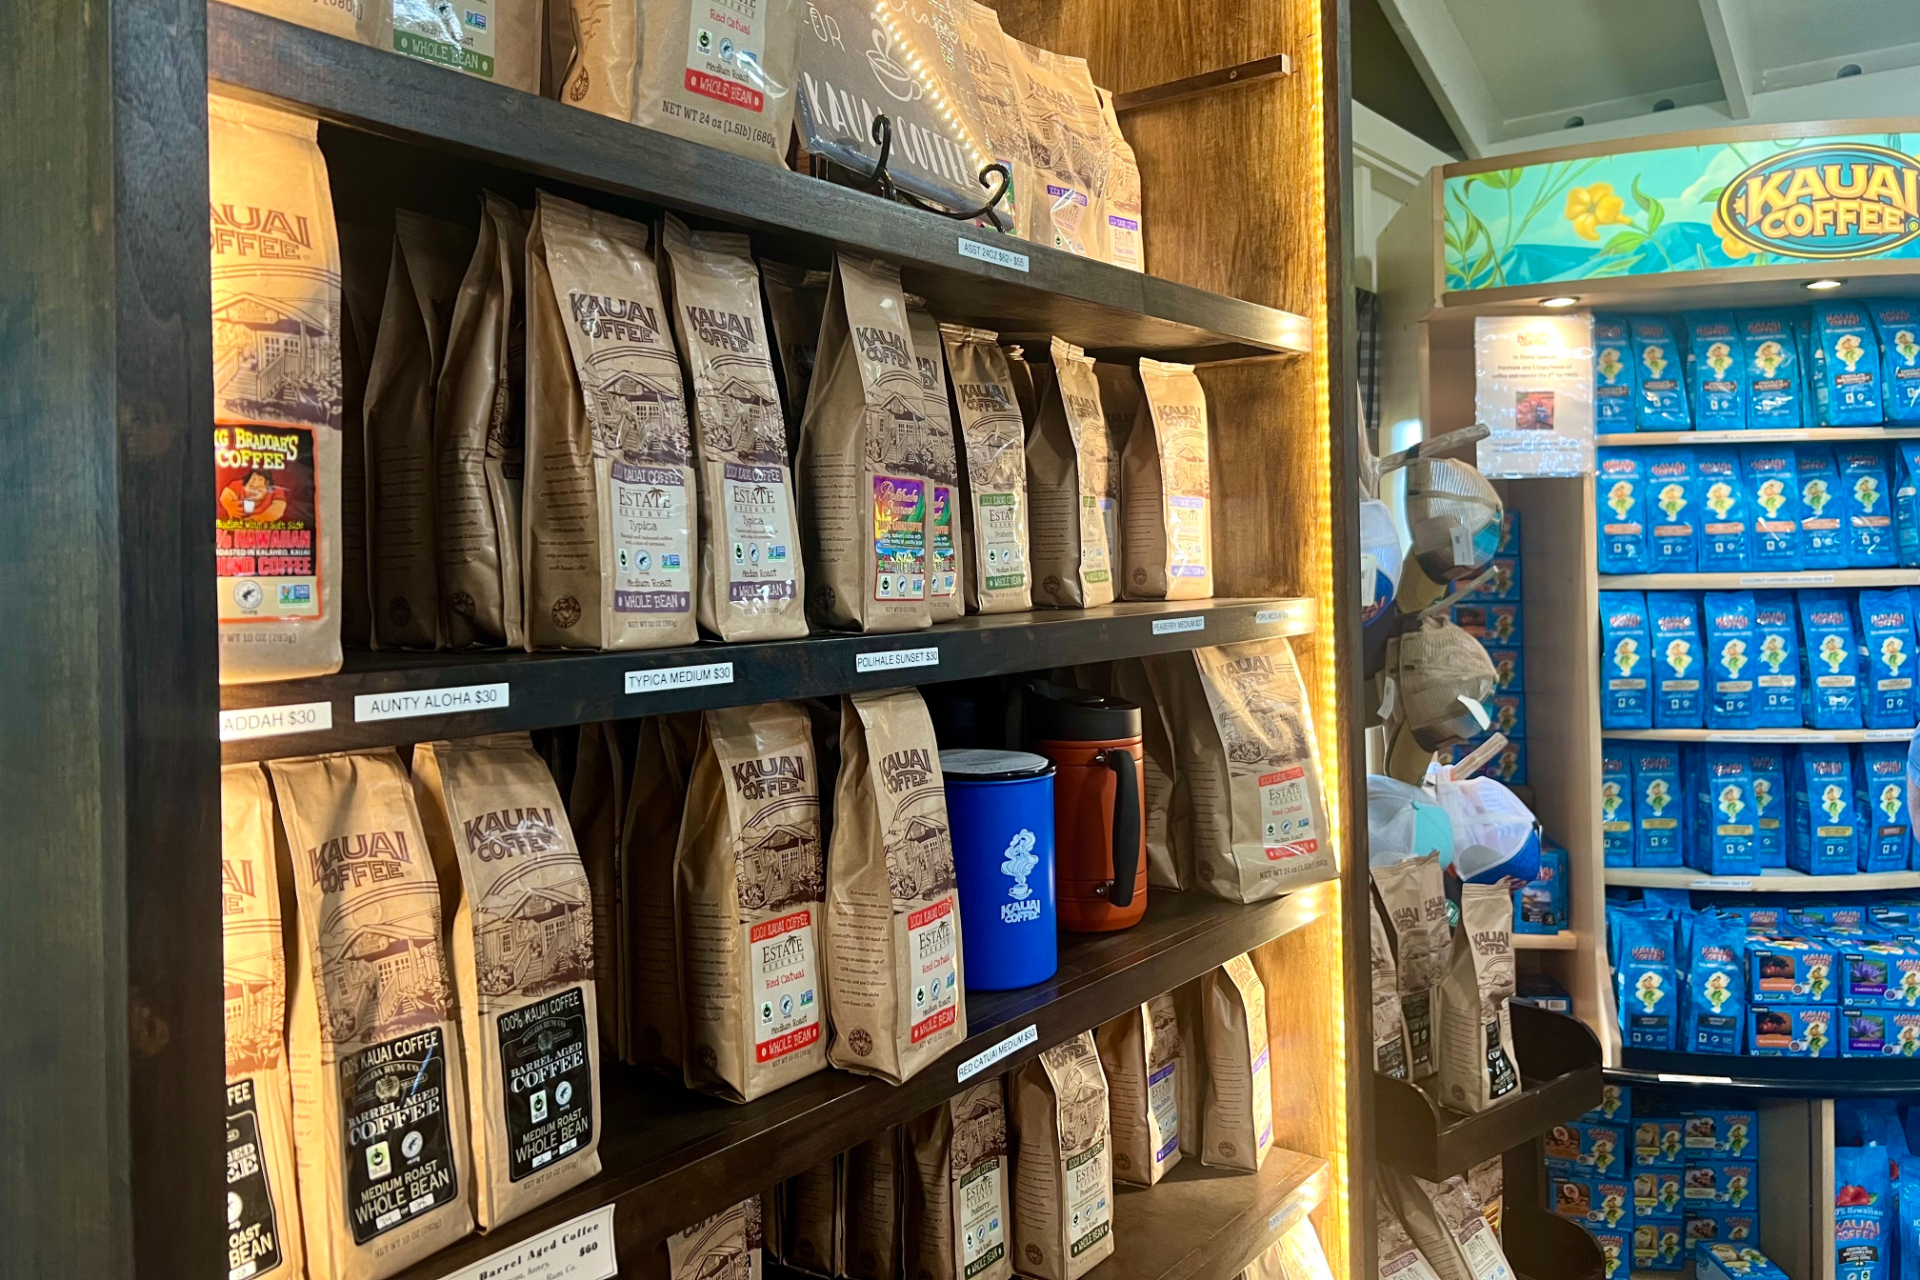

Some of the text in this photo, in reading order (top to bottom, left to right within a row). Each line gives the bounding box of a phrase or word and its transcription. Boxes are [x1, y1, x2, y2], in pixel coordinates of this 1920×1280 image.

[709, 9, 725, 21] Red
[412, 41, 479, 70] WHOLE BEAN
[705, 61, 750, 84] Medium Roast
[700, 77, 753, 105] WHOLE BEAN
[662, 100, 723, 130] NET WT 24 oz
[897, 115, 976, 188] COFFEE
[1744, 163, 1919, 229] KAUAI
[1759, 201, 1906, 240] COFFEE
[964, 243, 981, 256] ASST
[569, 292, 661, 336] KAUAI
[685, 305, 756, 345] KAUAI
[579, 318, 655, 344] COFFEE
[699, 327, 751, 353] COFFEE
[855, 327, 912, 363] KAUAI
[866, 346, 911, 371] COFFEE
[959, 384, 1013, 406] KAUAI
[966, 400, 1010, 413] COFFEE
[1067, 394, 1100, 417] KAUAI
[1157, 405, 1202, 424] KAUAI
[1164, 416, 1200, 429] COFFEE
[216, 449, 286, 470] COFFEE
[623, 467, 682, 486] KAUAI COFFEE
[752, 468, 781, 483] COFFEE
[618, 486, 672, 510] ESTATE
[732, 484, 776, 505] ESTATE
[879, 481, 919, 503] Polihale
[628, 519, 658, 533] Typica
[742, 515, 765, 527] Typica
[234, 529, 312, 550] HAWAIIAN
[257, 556, 313, 577] COFFEE
[760, 568, 778, 578] Roast
[627, 578, 673, 588] Medium Roast
[993, 576, 1011, 587] WHOLE
[624, 594, 679, 609] WHOLE BEAN
[1153, 619, 1196, 632] PEABERRY MEDIUM
[226, 632, 241, 644] WT
[857, 649, 938, 668] POLIHALE SUNSET $30
[1217, 655, 1275, 684] KAUAI
[628, 666, 731, 689] TYPICA MEDIUM $30
[370, 688, 498, 714] AUNTY ALOHA $30
[223, 708, 316, 732] ADDAH $30
[731, 755, 806, 793] KAUAI
[879, 748, 934, 786] KAUAI
[742, 777, 802, 801] COFFEE
[886, 770, 930, 795] COFFEE
[1268, 784, 1302, 801] ESTATE
[463, 807, 564, 854] KAUAI
[307, 831, 413, 888] KAUAI
[477, 832, 560, 863] COFFEE
[320, 860, 405, 895] COFFEE
[1259, 866, 1291, 880] NET WT 24
[923, 906, 938, 924] KAUAI
[1000, 899, 1041, 920] KAUAI
[1004, 910, 1040, 924] COFFEE
[752, 914, 809, 941] 100% KAUAI COFFEE
[918, 923, 951, 951] ESTATE
[1471, 930, 1510, 948] KAUAI
[761, 937, 805, 965] ESTATE
[761, 954, 806, 974] RESERVE
[922, 962, 933, 975] Red
[765, 977, 780, 990] Red
[500, 990, 581, 1034] 100% KAUAI COFFEE
[922, 996, 952, 1018] Medium Roast
[1844, 998, 1853, 1006] 10
[771, 1014, 808, 1036] Medium Roast
[919, 1010, 955, 1039] WHOLE BEAN
[360, 1030, 440, 1069] KAUAI COFFEE
[768, 1029, 812, 1057] WHOLE BEAN
[958, 1028, 1036, 1078] RED CATUAI MEDIUM $30
[384, 1061, 407, 1074] RUM
[510, 1041, 583, 1079] BARREL AGED
[1052, 1044, 1089, 1070] COFFEE
[510, 1050, 585, 1094] COFFEE
[348, 1086, 440, 1132] BARREL AGED
[348, 1096, 442, 1147] COFFEE
[522, 1107, 583, 1146] MEDIUM ROAST
[515, 1115, 589, 1165] WHOLE BEAN
[360, 1159, 439, 1203] MEDIUM ROAST
[1075, 1159, 1103, 1184] ESTATE
[355, 1168, 450, 1225] WHOLE BEAN
[966, 1176, 994, 1202] ESTATE
[1079, 1181, 1100, 1199] Peaberry
[1077, 1225, 1106, 1252] WHOLE BEAN
[1835, 1219, 1881, 1235] KAUAI
[1836, 1229, 1878, 1241] COFFEE
[228, 1232, 274, 1270] BEAN
[478, 1222, 600, 1280] Barrel Aged Coffee
[578, 1240, 599, 1257] $60
[970, 1247, 998, 1274] WHOLE BEAN
[526, 1260, 552, 1276] honey,
